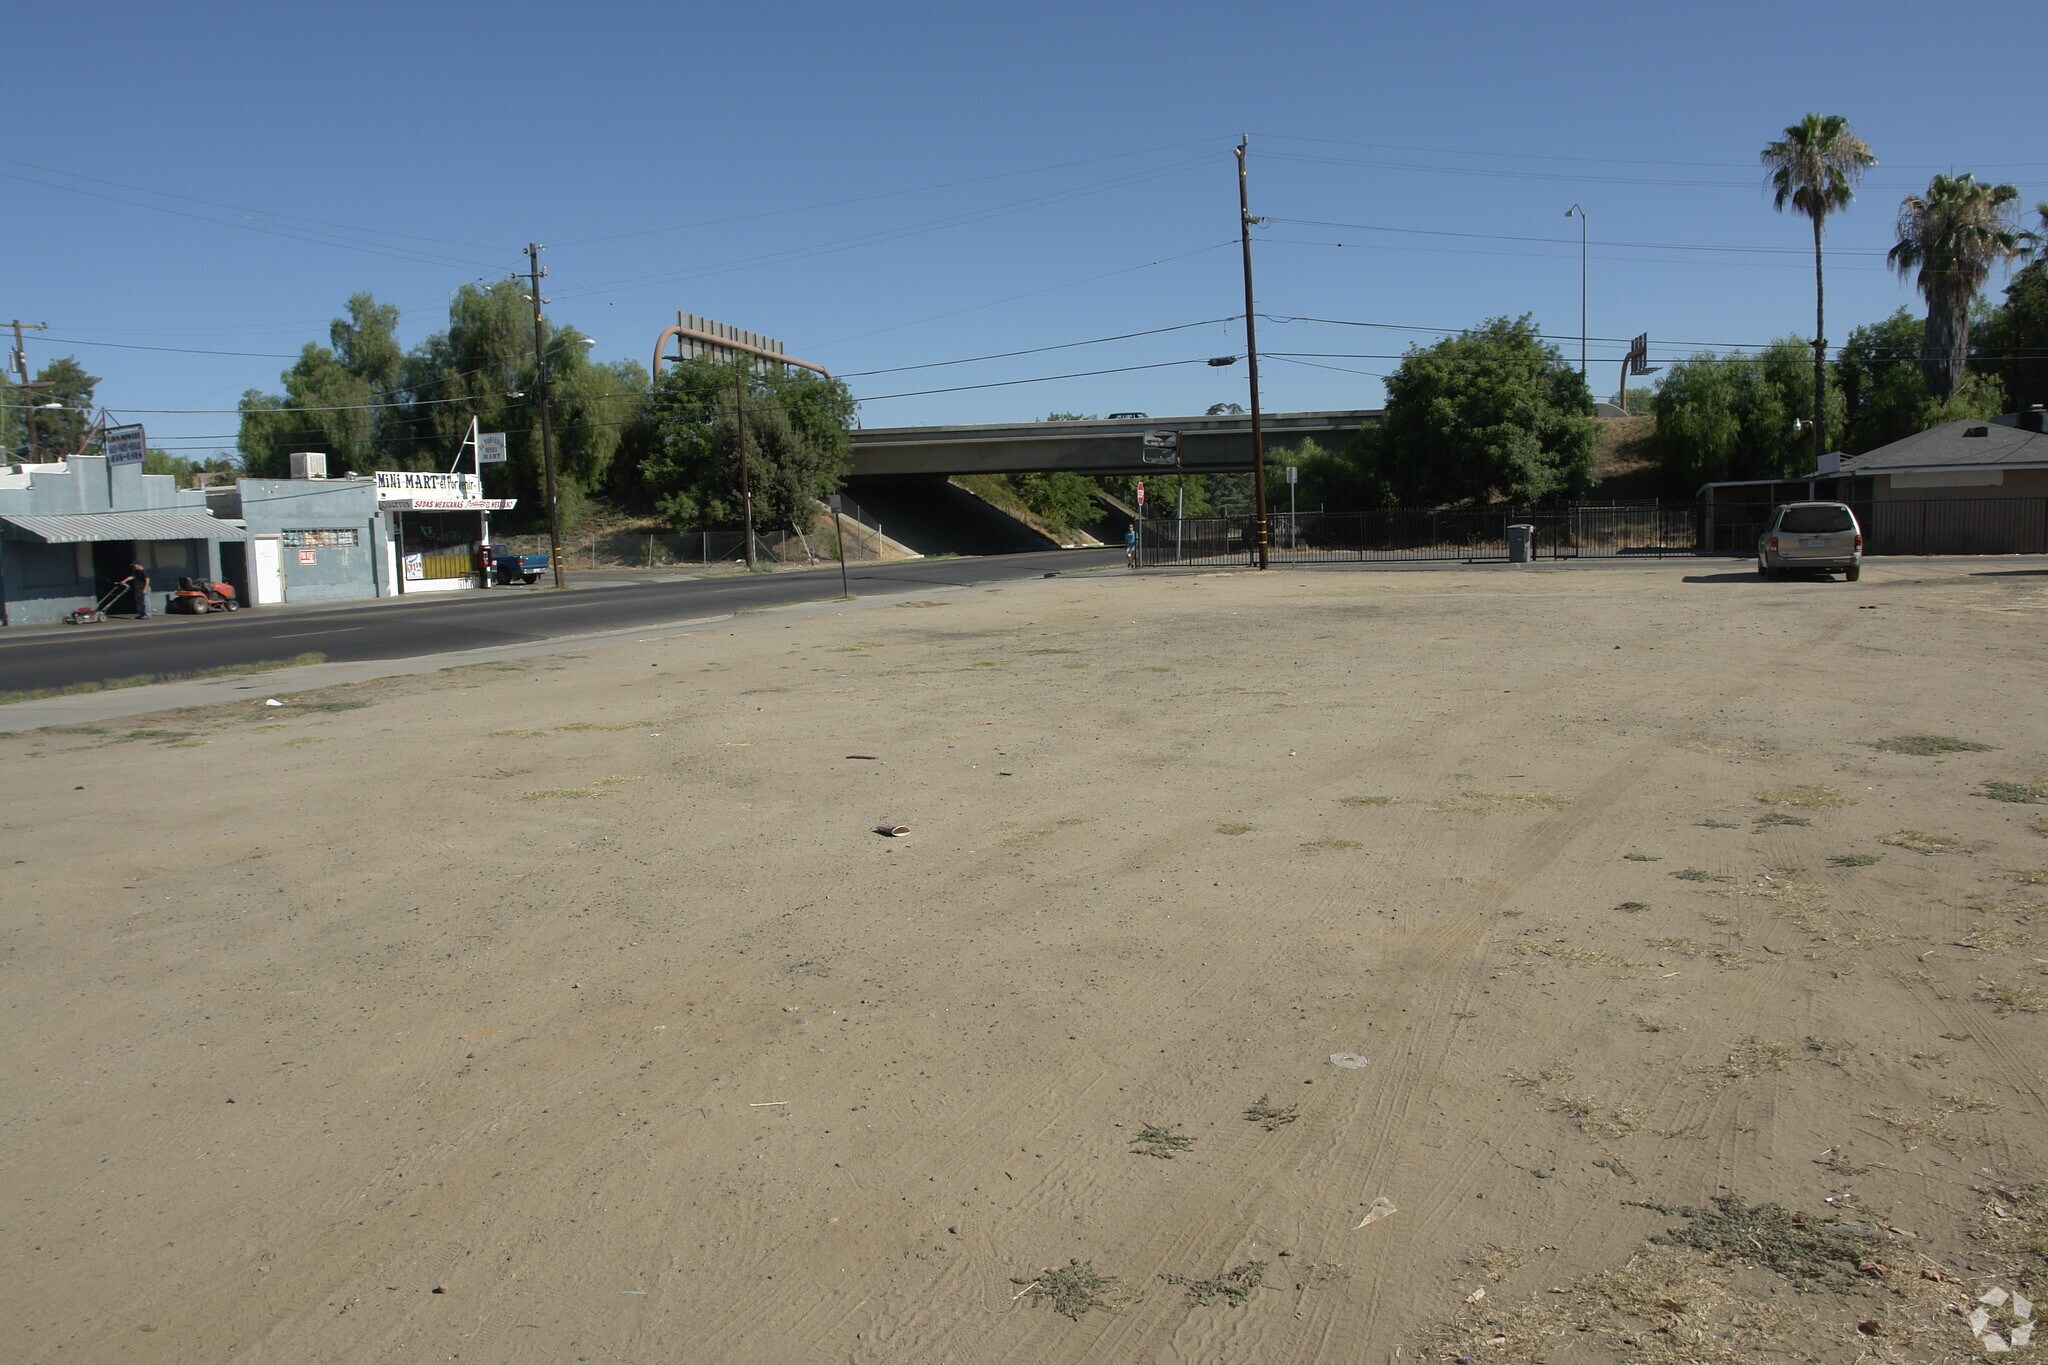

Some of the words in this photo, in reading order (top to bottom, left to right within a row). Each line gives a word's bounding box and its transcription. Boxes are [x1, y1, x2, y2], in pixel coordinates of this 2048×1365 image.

[405, 474, 437, 489] MART
[414, 500, 433, 508] SODAS
[434, 500, 464, 508] MEXICANAS
